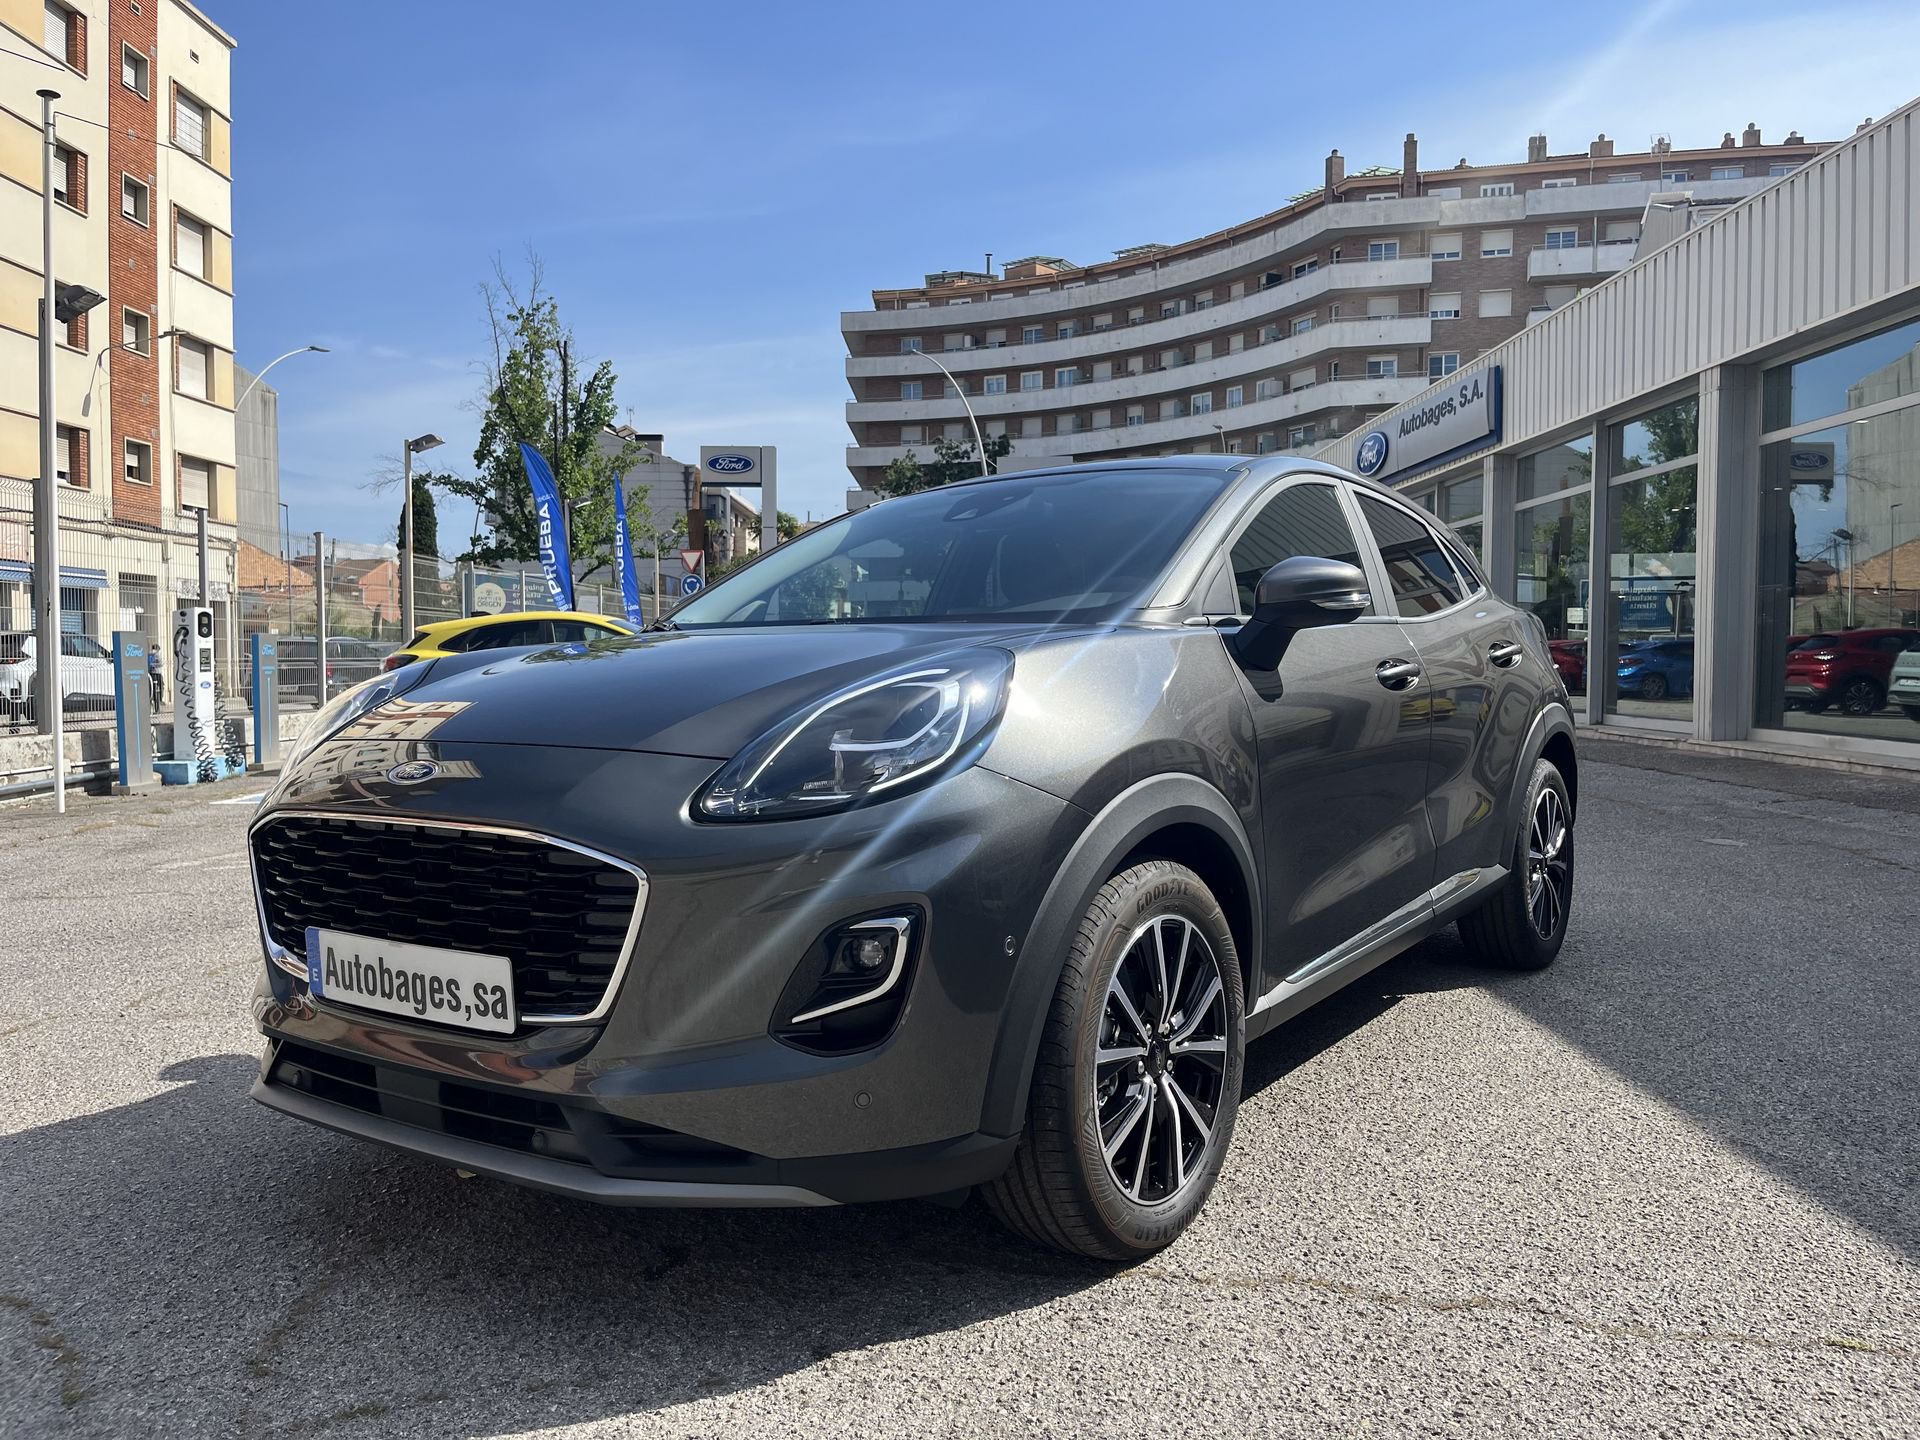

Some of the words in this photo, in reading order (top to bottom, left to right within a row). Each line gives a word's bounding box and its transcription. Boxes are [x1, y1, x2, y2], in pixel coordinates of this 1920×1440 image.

[1399, 397, 1457, 439] Autobages,
[1459, 379, 1484, 408] S.A.
[715, 457, 745, 470] Ford
[1360, 439, 1378, 468] Ford
[539, 502, 562, 595] PRUEBA
[125, 643, 144, 657] Ford
[261, 643, 275, 656] Ford
[312, 968, 319, 982] E
[325, 946, 509, 1022] Autobages,sa
